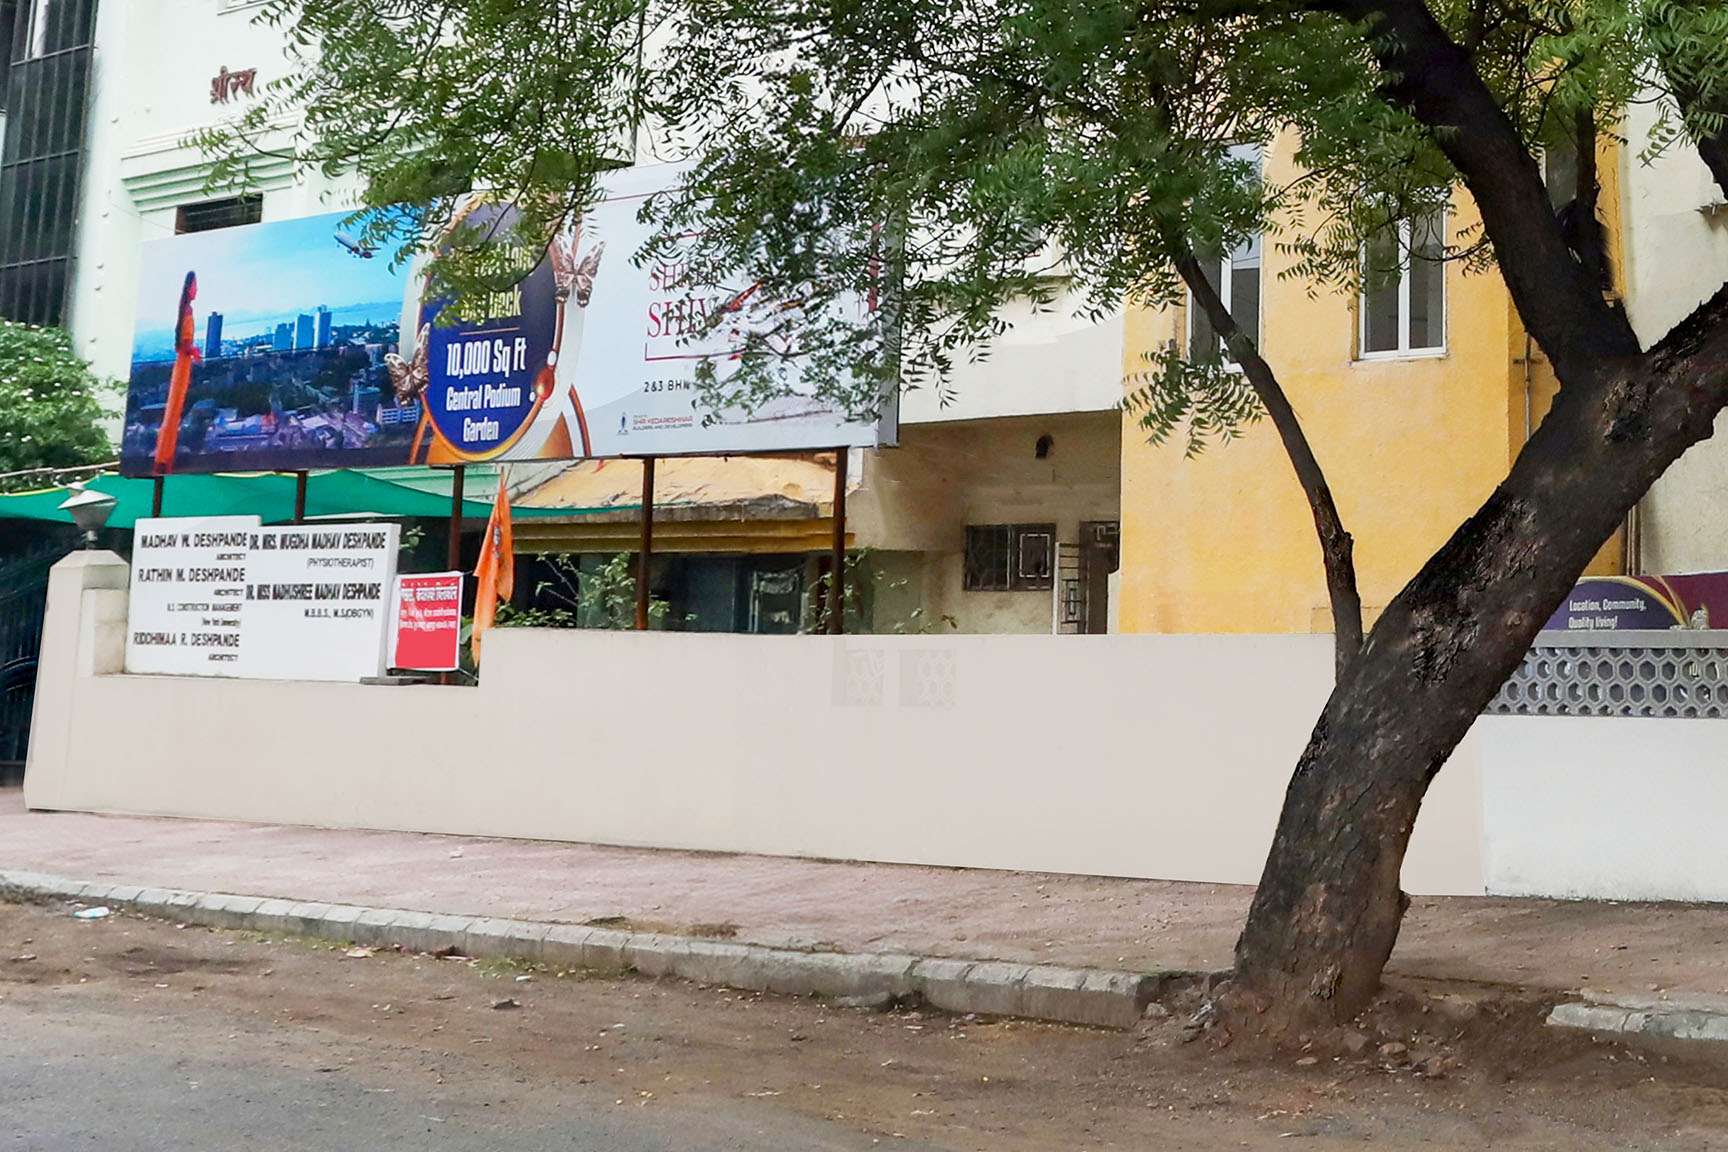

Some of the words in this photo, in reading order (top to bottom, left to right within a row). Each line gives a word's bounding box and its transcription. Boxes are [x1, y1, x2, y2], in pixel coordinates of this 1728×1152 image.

[446, 340, 491, 379] 10,000
[493, 339, 511, 378] Sq
[513, 337, 527, 371] Ft
[643, 380, 664, 393] 2&3
[446, 384, 483, 411] Central
[484, 383, 521, 408] Podium
[463, 416, 499, 442] Garden
[194, 532, 247, 547] DESHPANDE
[343, 532, 386, 549] DESHPANDE
[189, 568, 245, 582] DESHPANDE
[343, 583, 381, 600] DESHPANDE
[1569, 600, 1601, 611] Location,
[1602, 598, 1647, 612] Community,
[1568, 617, 1594, 631] Quality
[191, 633, 240, 647] DESHPANDE
